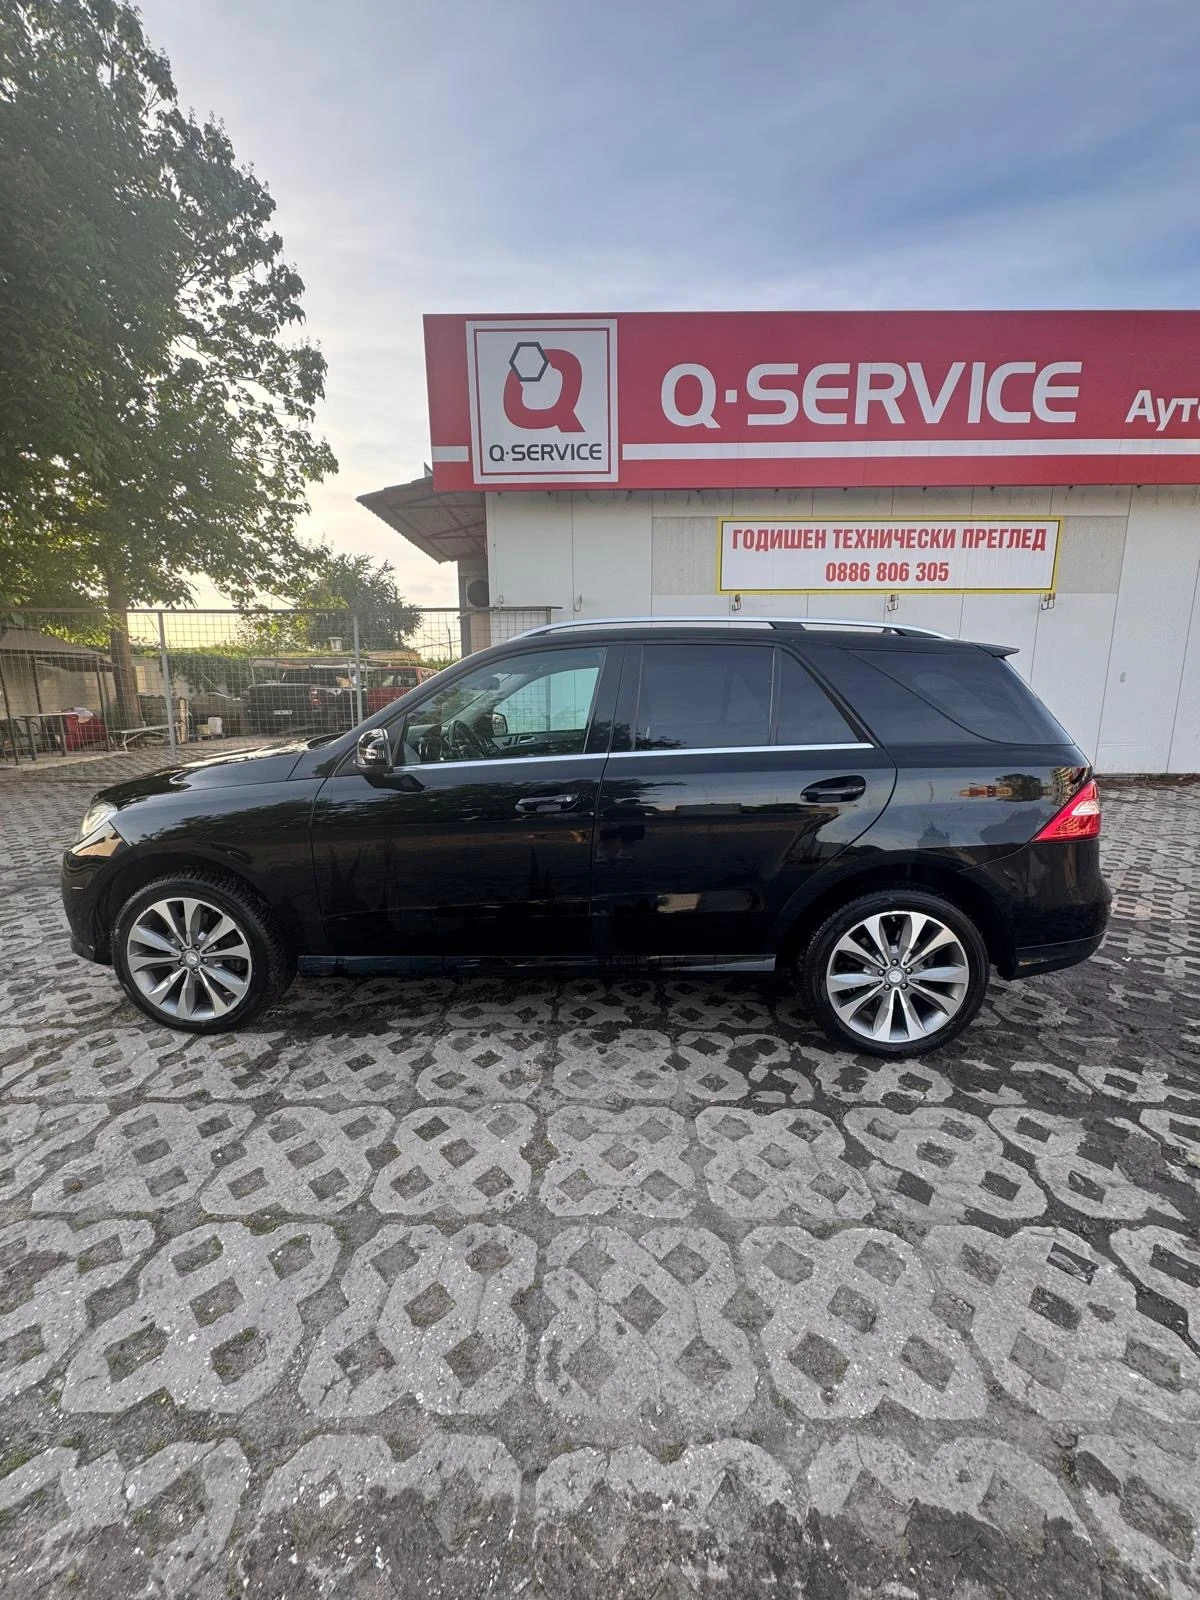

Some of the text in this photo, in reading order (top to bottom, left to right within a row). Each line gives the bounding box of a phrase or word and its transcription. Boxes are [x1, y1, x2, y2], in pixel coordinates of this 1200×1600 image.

[1124, 389, 1200, 432] Аут
[732, 528, 1047, 552] ГОДИШЕН ТЕХНИЧЕСКИ ПРЕГЛЕД
[825, 561, 949, 583] 0886 806 305
